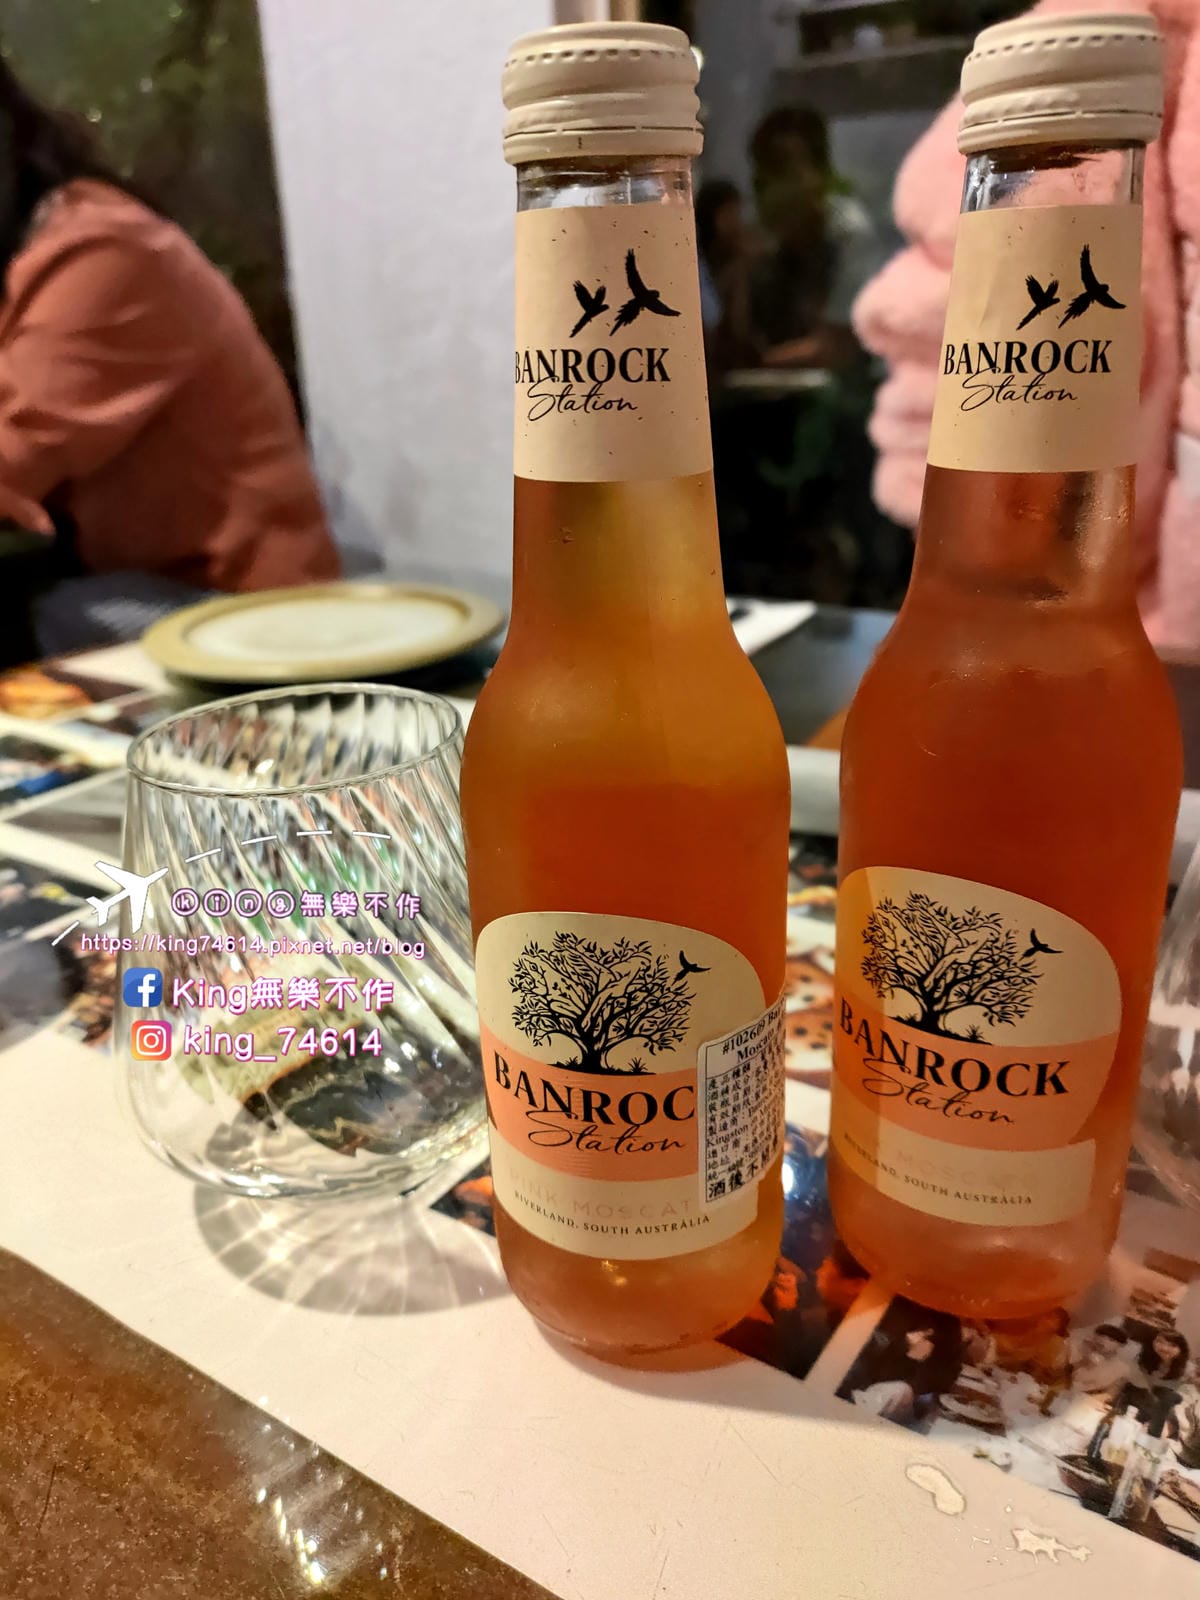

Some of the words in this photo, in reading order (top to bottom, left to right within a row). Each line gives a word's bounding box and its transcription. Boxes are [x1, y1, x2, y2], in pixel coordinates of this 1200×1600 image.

[515, 347, 672, 384] BANROCK
[942, 339, 1113, 376] BANROCK
[526, 375, 638, 422] Station
[960, 366, 1078, 412] Station
[840, 997, 1071, 1098] BANROCK
[493, 1050, 696, 1127] BANROC
[862, 1057, 1016, 1126] Station
[525, 1109, 686, 1155] Station
[571, 1198, 693, 1221] MOSCAT
[904, 1174, 949, 1196] SOUTH
[954, 1189, 1033, 1205] AUSTRALIA
[583, 1221, 629, 1236] SOUTH
[635, 1214, 711, 1235] AUSTRALIA
